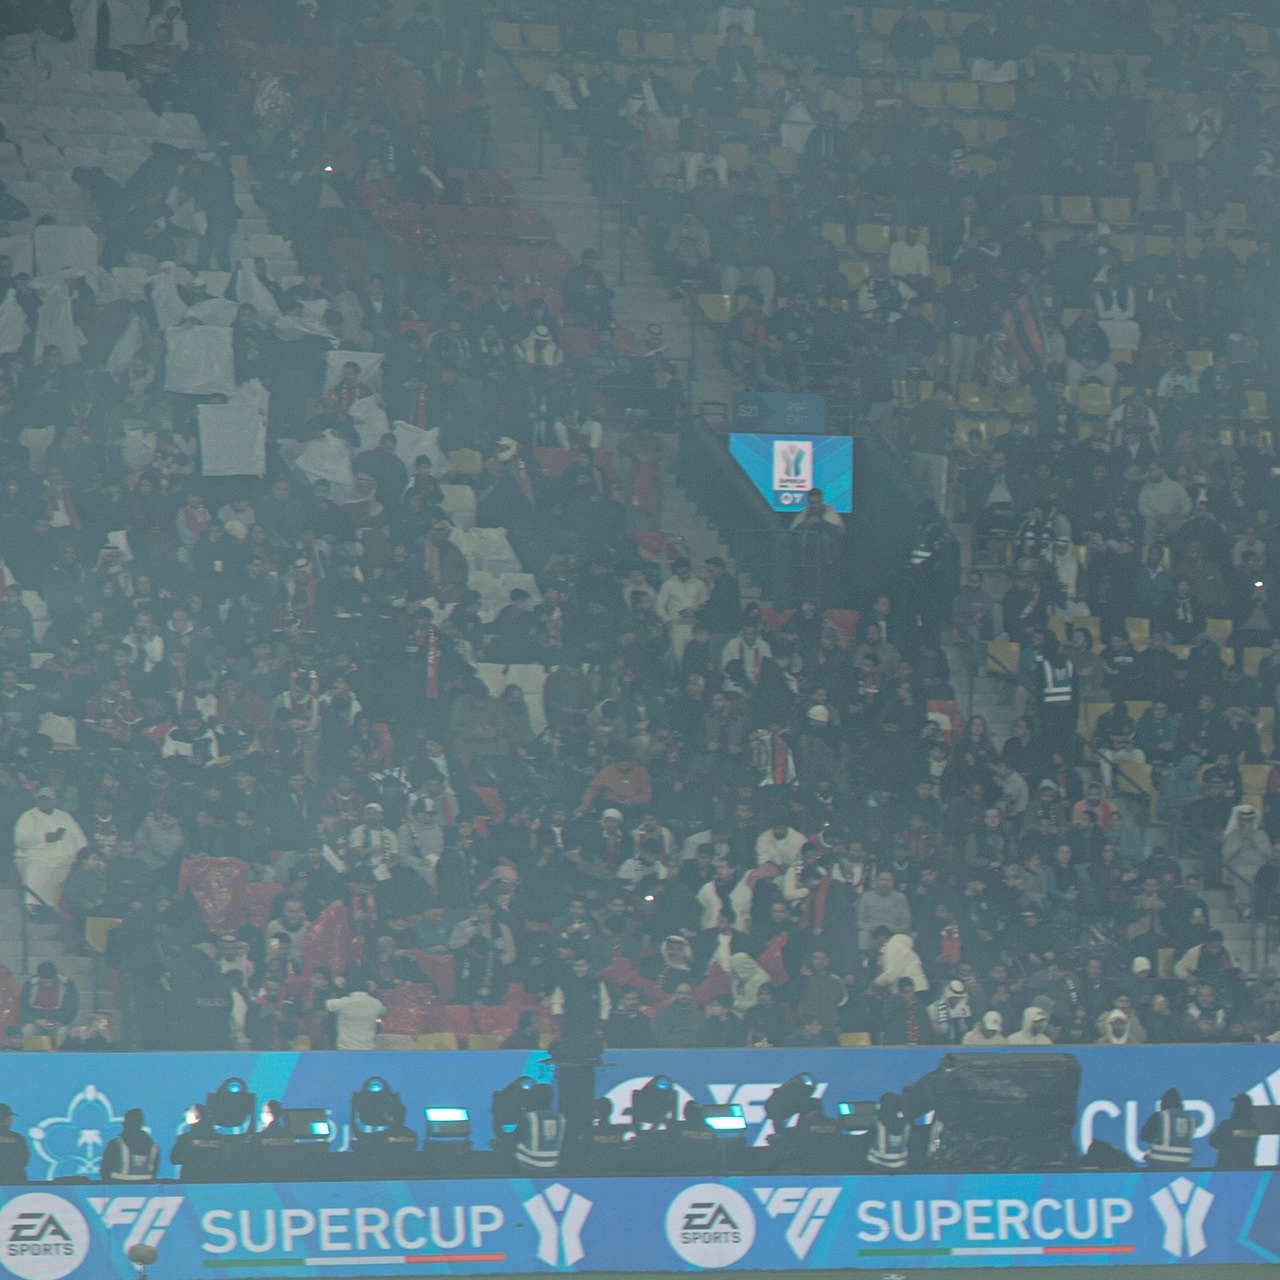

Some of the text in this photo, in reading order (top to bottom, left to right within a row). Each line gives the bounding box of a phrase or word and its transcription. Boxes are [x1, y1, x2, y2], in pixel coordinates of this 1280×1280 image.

[9, 1212, 73, 1241] EA
[202, 1204, 504, 1254] SUPERCUP
[682, 1202, 739, 1230] EA
[857, 1197, 1134, 1242] SUPERCUP
[8, 1243, 75, 1257] SPORTS
[681, 1231, 741, 1245] SPORTS
